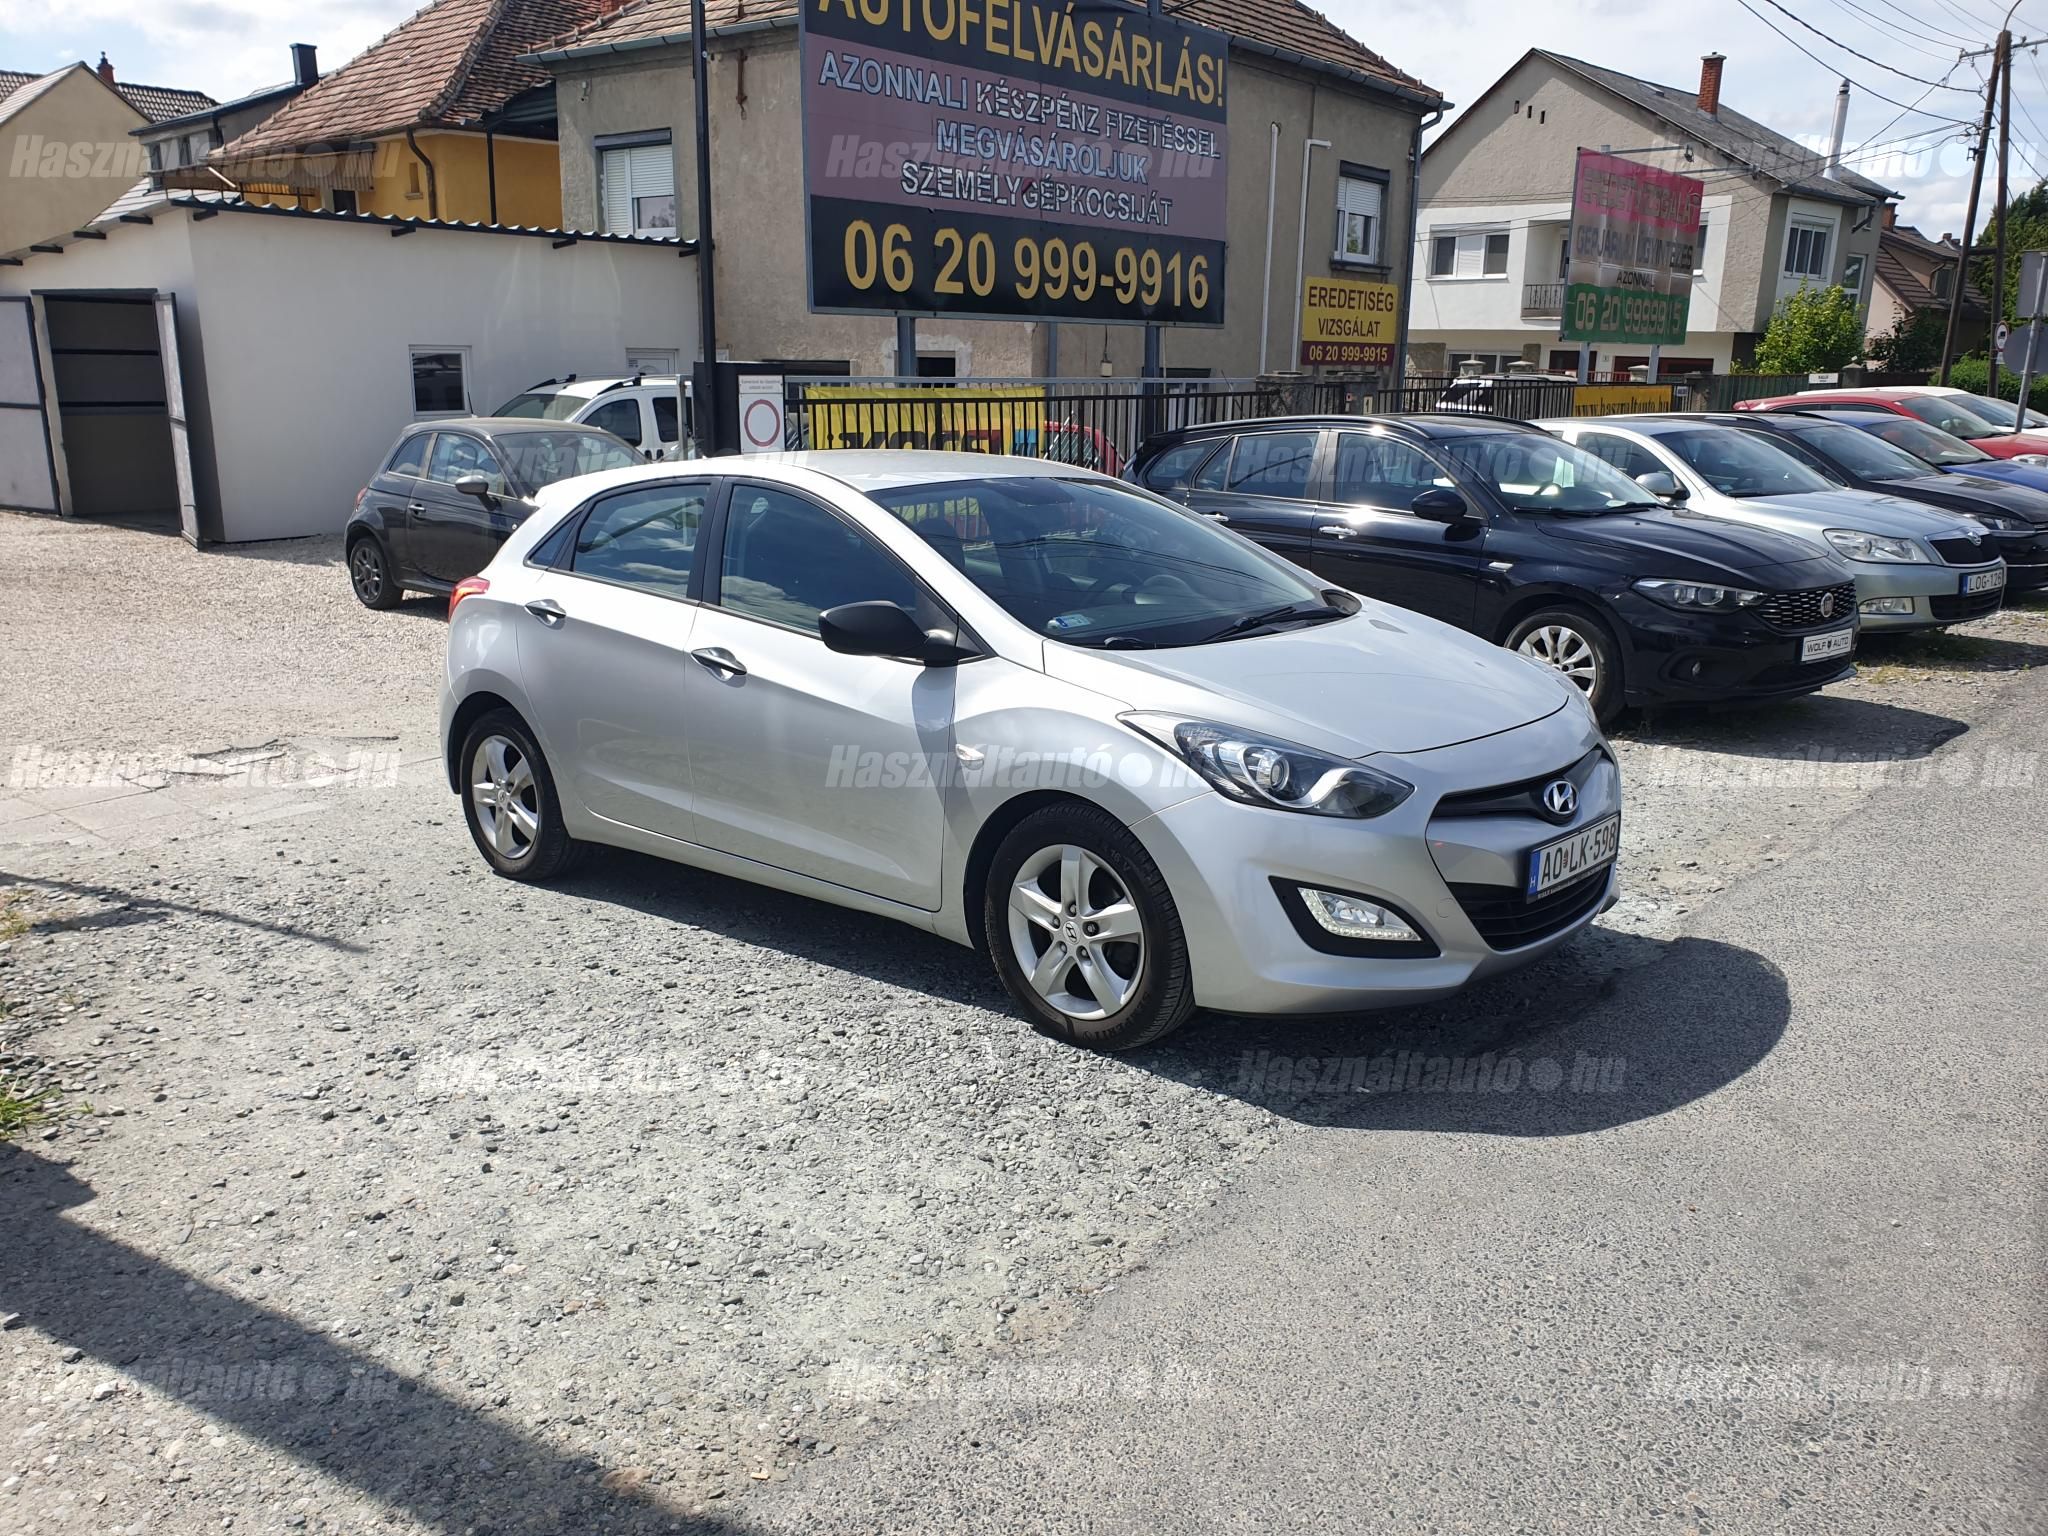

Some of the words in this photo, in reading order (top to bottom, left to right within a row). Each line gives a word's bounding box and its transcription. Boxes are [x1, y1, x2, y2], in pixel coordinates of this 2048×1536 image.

[818, 0, 1224, 107] TOFELVÁSÁRLÁS!
[818, 49, 968, 111] AZONNALI
[976, 79, 1100, 136] KÉSZPÉNZ
[1105, 108, 1220, 159] FIZETÉSSEL
[936, 119, 1147, 184] MEGVÁSÁROLJUK
[901, 160, 1173, 226] SZEMÉLYGÉPKOCSIJÁT
[844, 220, 913, 292] 06
[934, 228, 995, 297] 20
[1014, 237, 1208, 309] 999-9916
[1308, 286, 1394, 312] EREDETISÉG
[1575, 292, 1595, 331] 06
[1600, 294, 1620, 332] 20
[1318, 316, 1381, 337] VIZSGÁLAT
[1309, 345, 1323, 361] 06
[1326, 345, 1338, 361] 20
[1341, 346, 1388, 362] 999-9915
[1807, 641, 1826, 653] WOLF
[1833, 636, 1848, 648] AUTO
